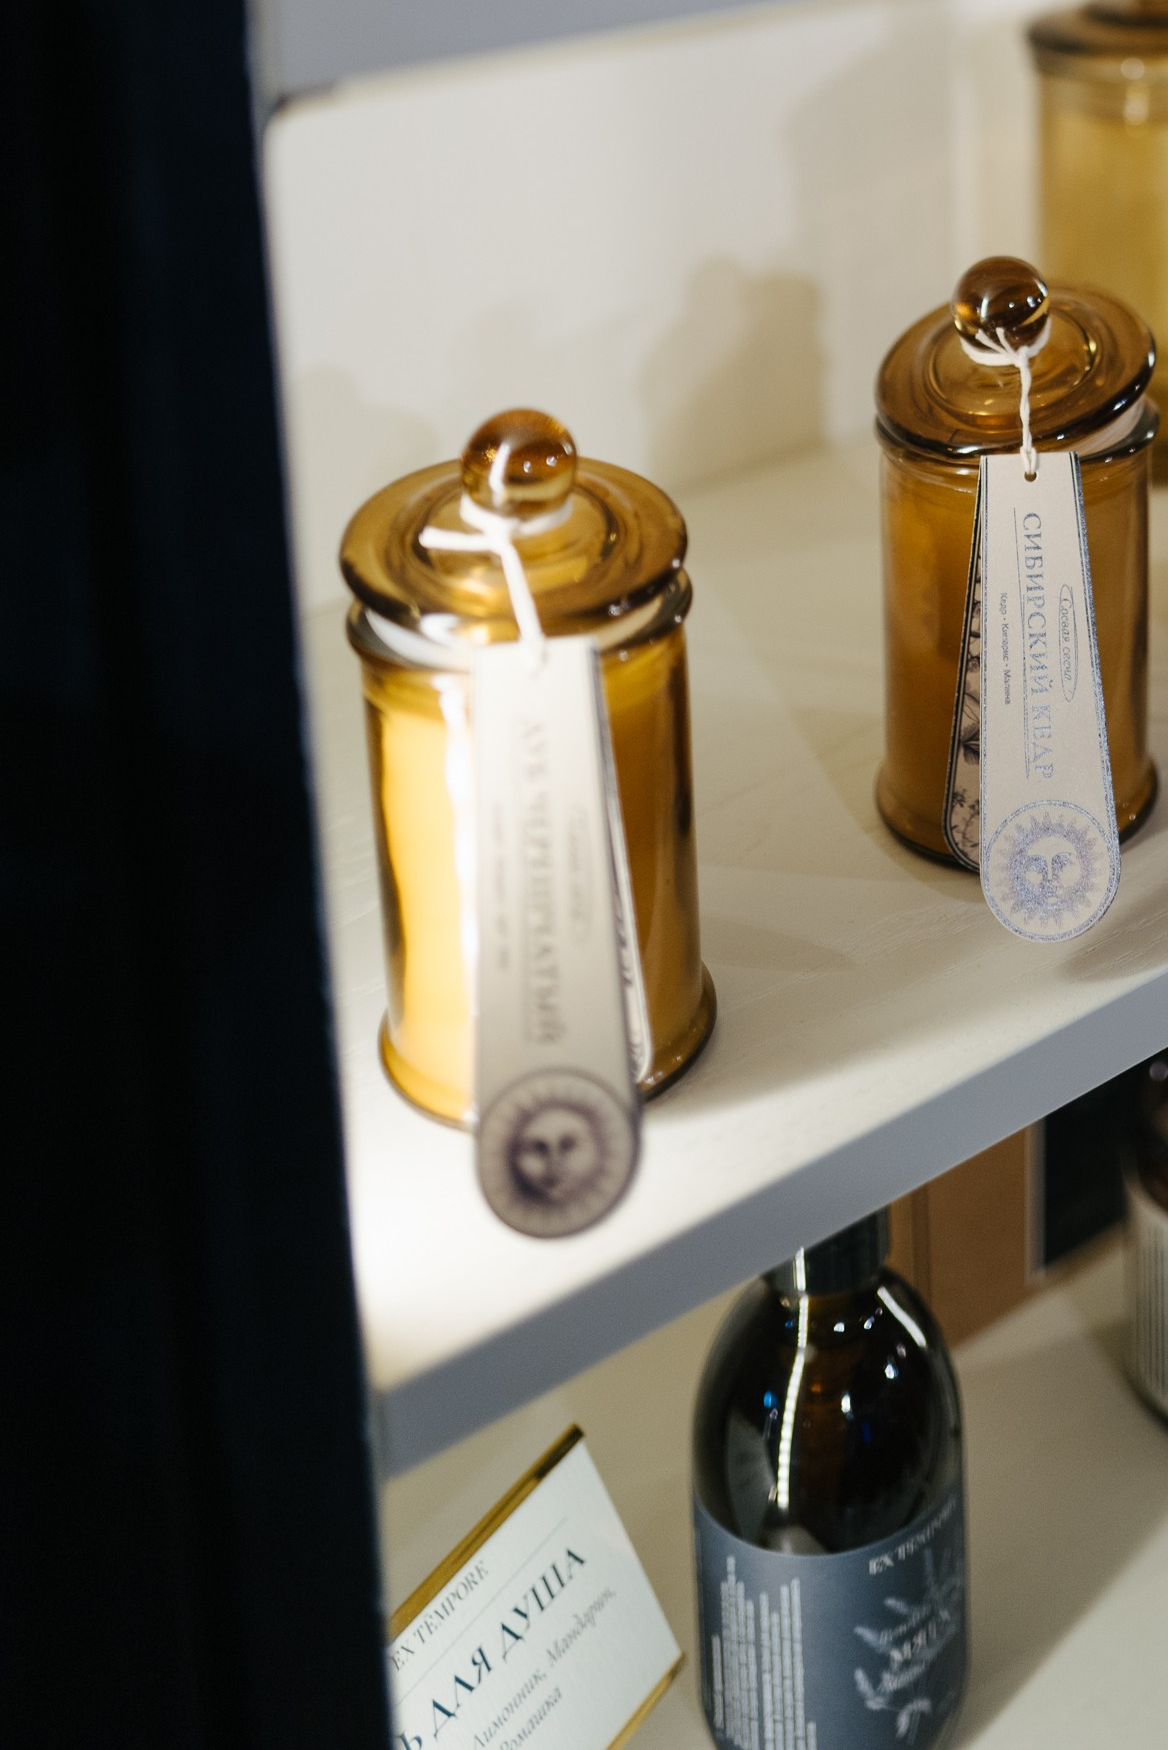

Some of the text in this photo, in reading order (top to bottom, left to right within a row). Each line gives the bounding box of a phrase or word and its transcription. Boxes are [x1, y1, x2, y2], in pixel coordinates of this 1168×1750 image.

[1000, 592, 1012, 705] Кедр Кипарис Малина
[1022, 511, 1054, 779] СИБИРСКИЙ КЕДР
[390, 1560, 490, 1671] EX TĒMPORE
[432, 1643, 492, 1742] ДЛЯ
[500, 1548, 586, 1661] ДУША
[473, 1669, 548, 1750] Лимонник,
